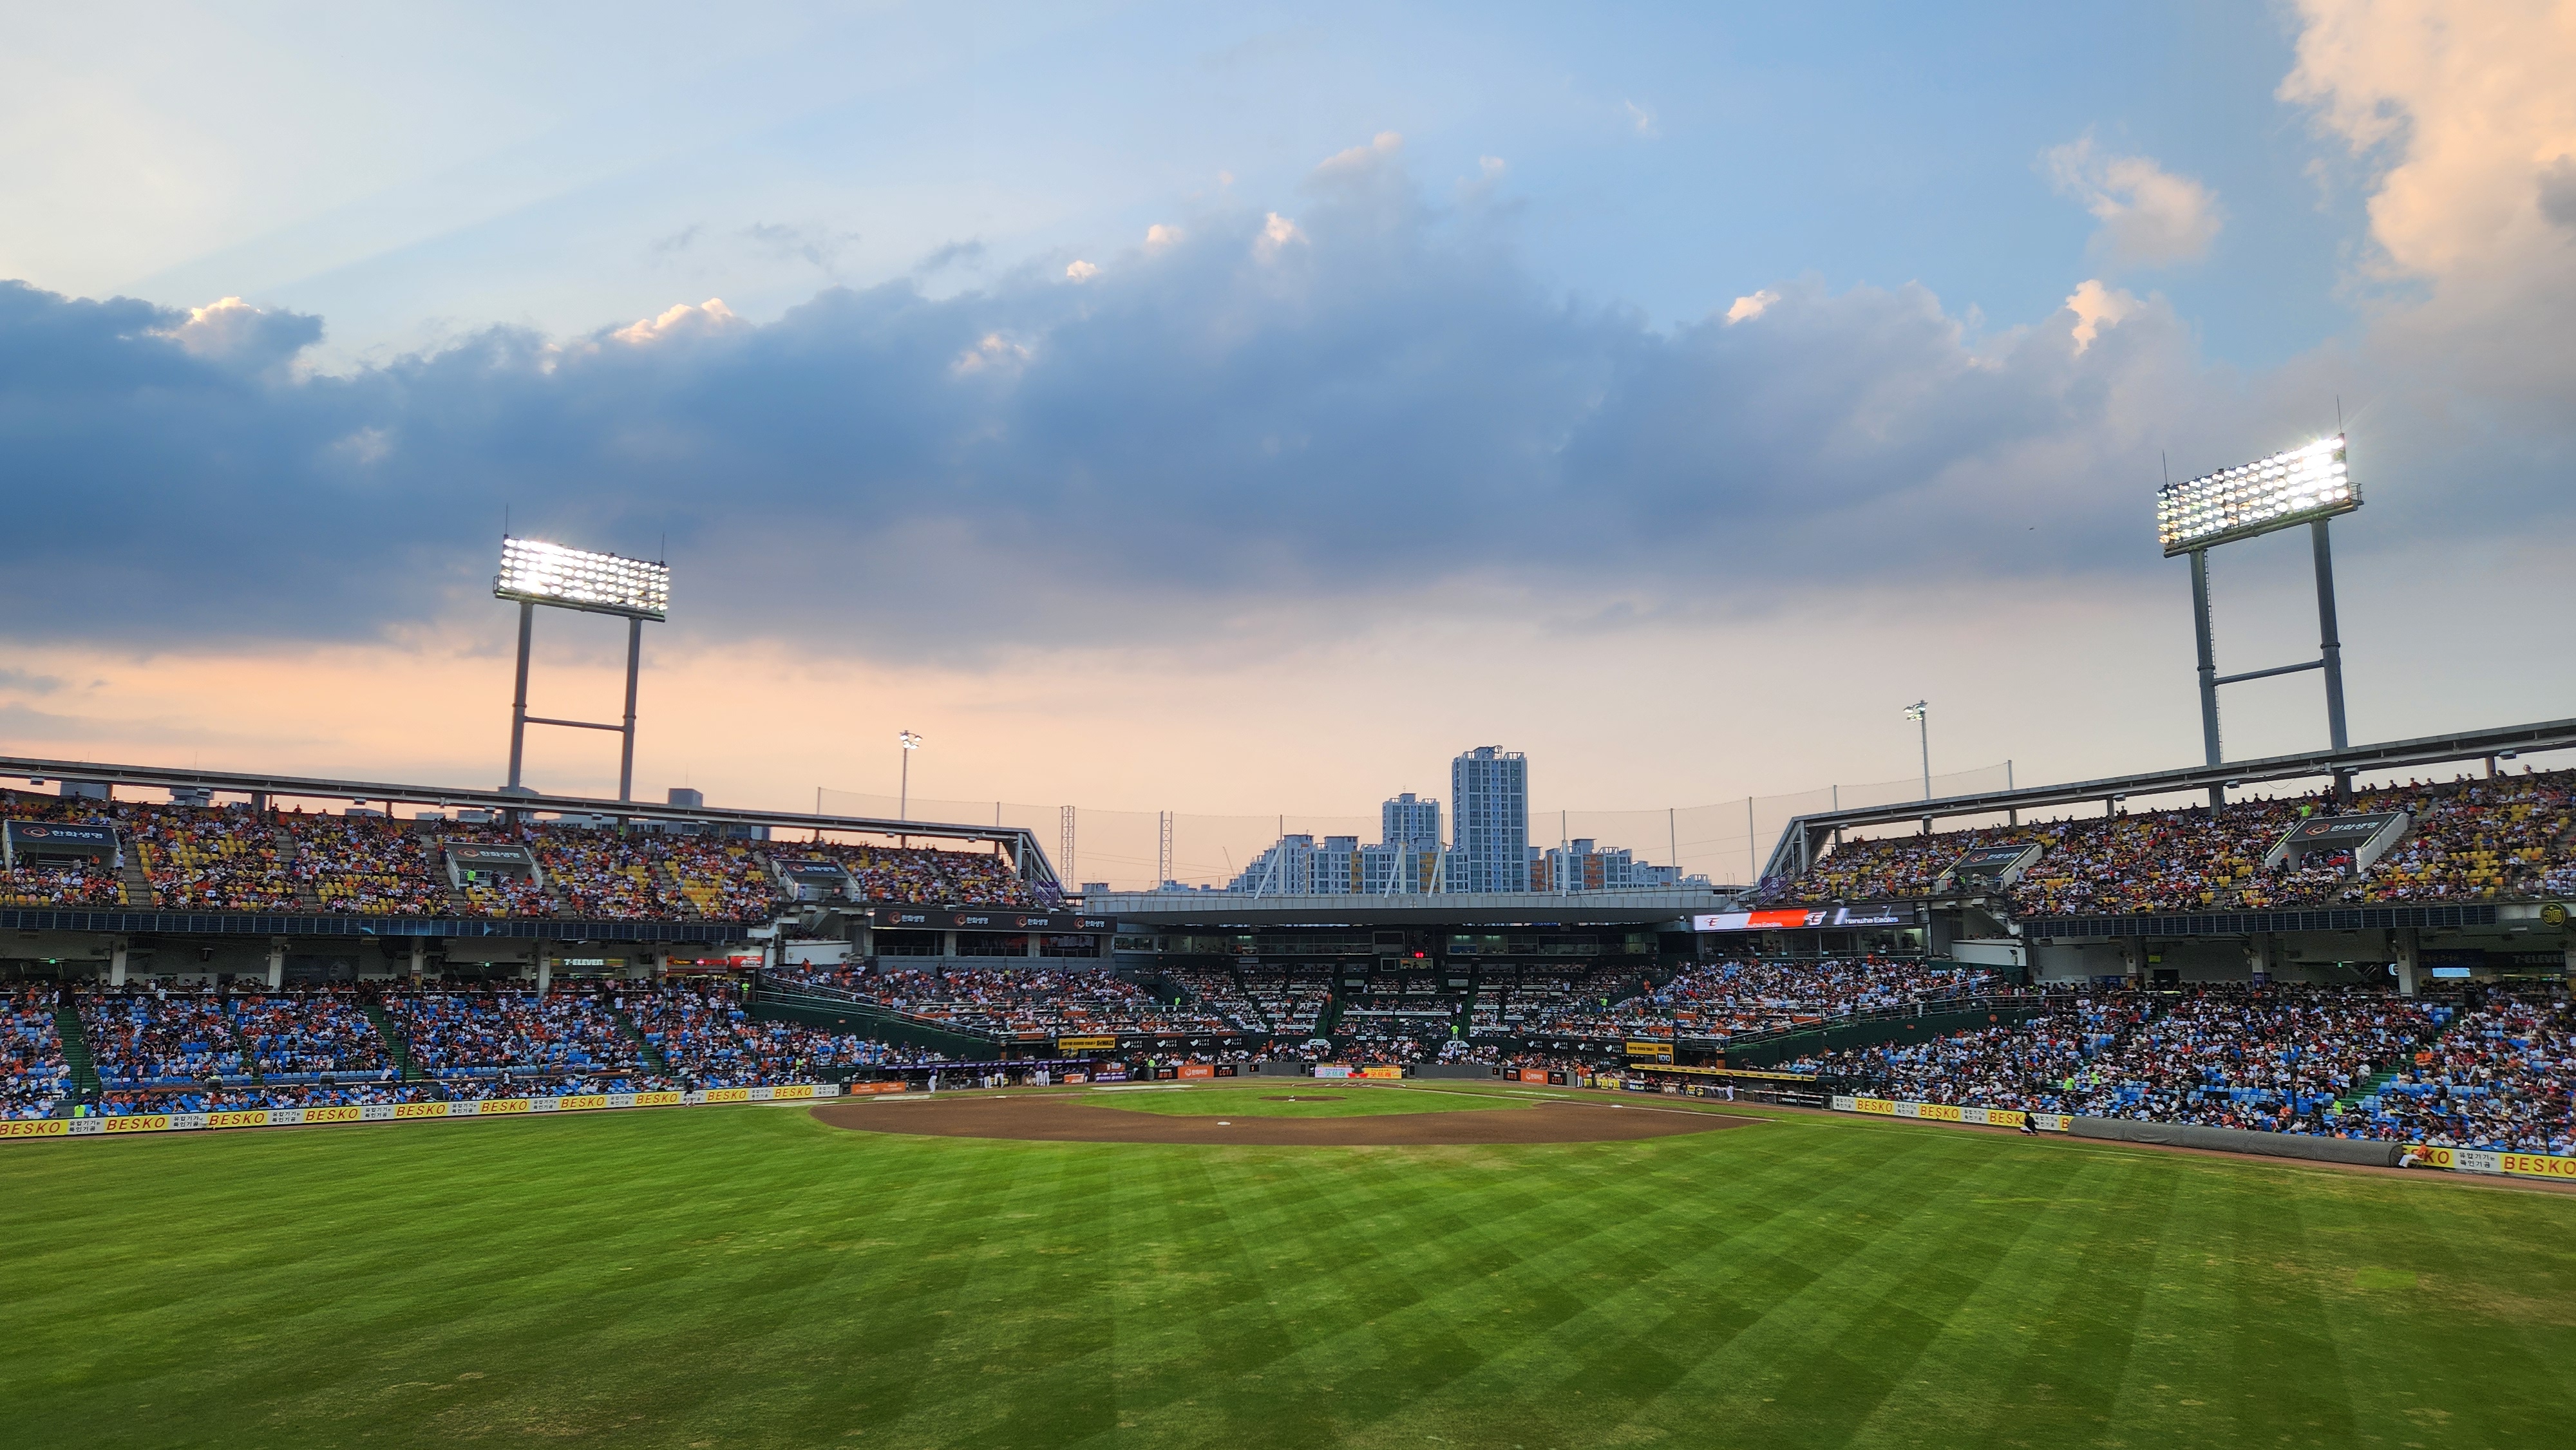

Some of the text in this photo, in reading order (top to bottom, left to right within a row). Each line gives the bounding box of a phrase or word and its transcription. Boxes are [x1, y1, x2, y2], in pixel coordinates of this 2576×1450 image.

[2331, 822, 2380, 831] 한화생명
[52, 830, 103, 839] 한화생명
[2544, 910, 2561, 923] 35
[636, 1093, 677, 1104] BESKO
[707, 1090, 747, 1101] BESKO
[775, 1087, 811, 1098] BESKO
[481, 1100, 527, 1113] BESKO
[560, 1097, 605, 1108] BESKO
[1857, 1100, 1893, 1113] BESKO
[306, 1109, 358, 1121] BESKO
[396, 1104, 446, 1116] BESKO
[1920, 1106, 1959, 1118] BESKO
[107, 1117, 166, 1130] BESKO
[209, 1113, 265, 1125] BESKO
[1990, 1112, 2024, 1125] BESK
[0, 1122, 61, 1135] BESKO
[2459, 1153, 2496, 1161] 유압기기는
[2504, 1156, 2576, 1174] BESKO
